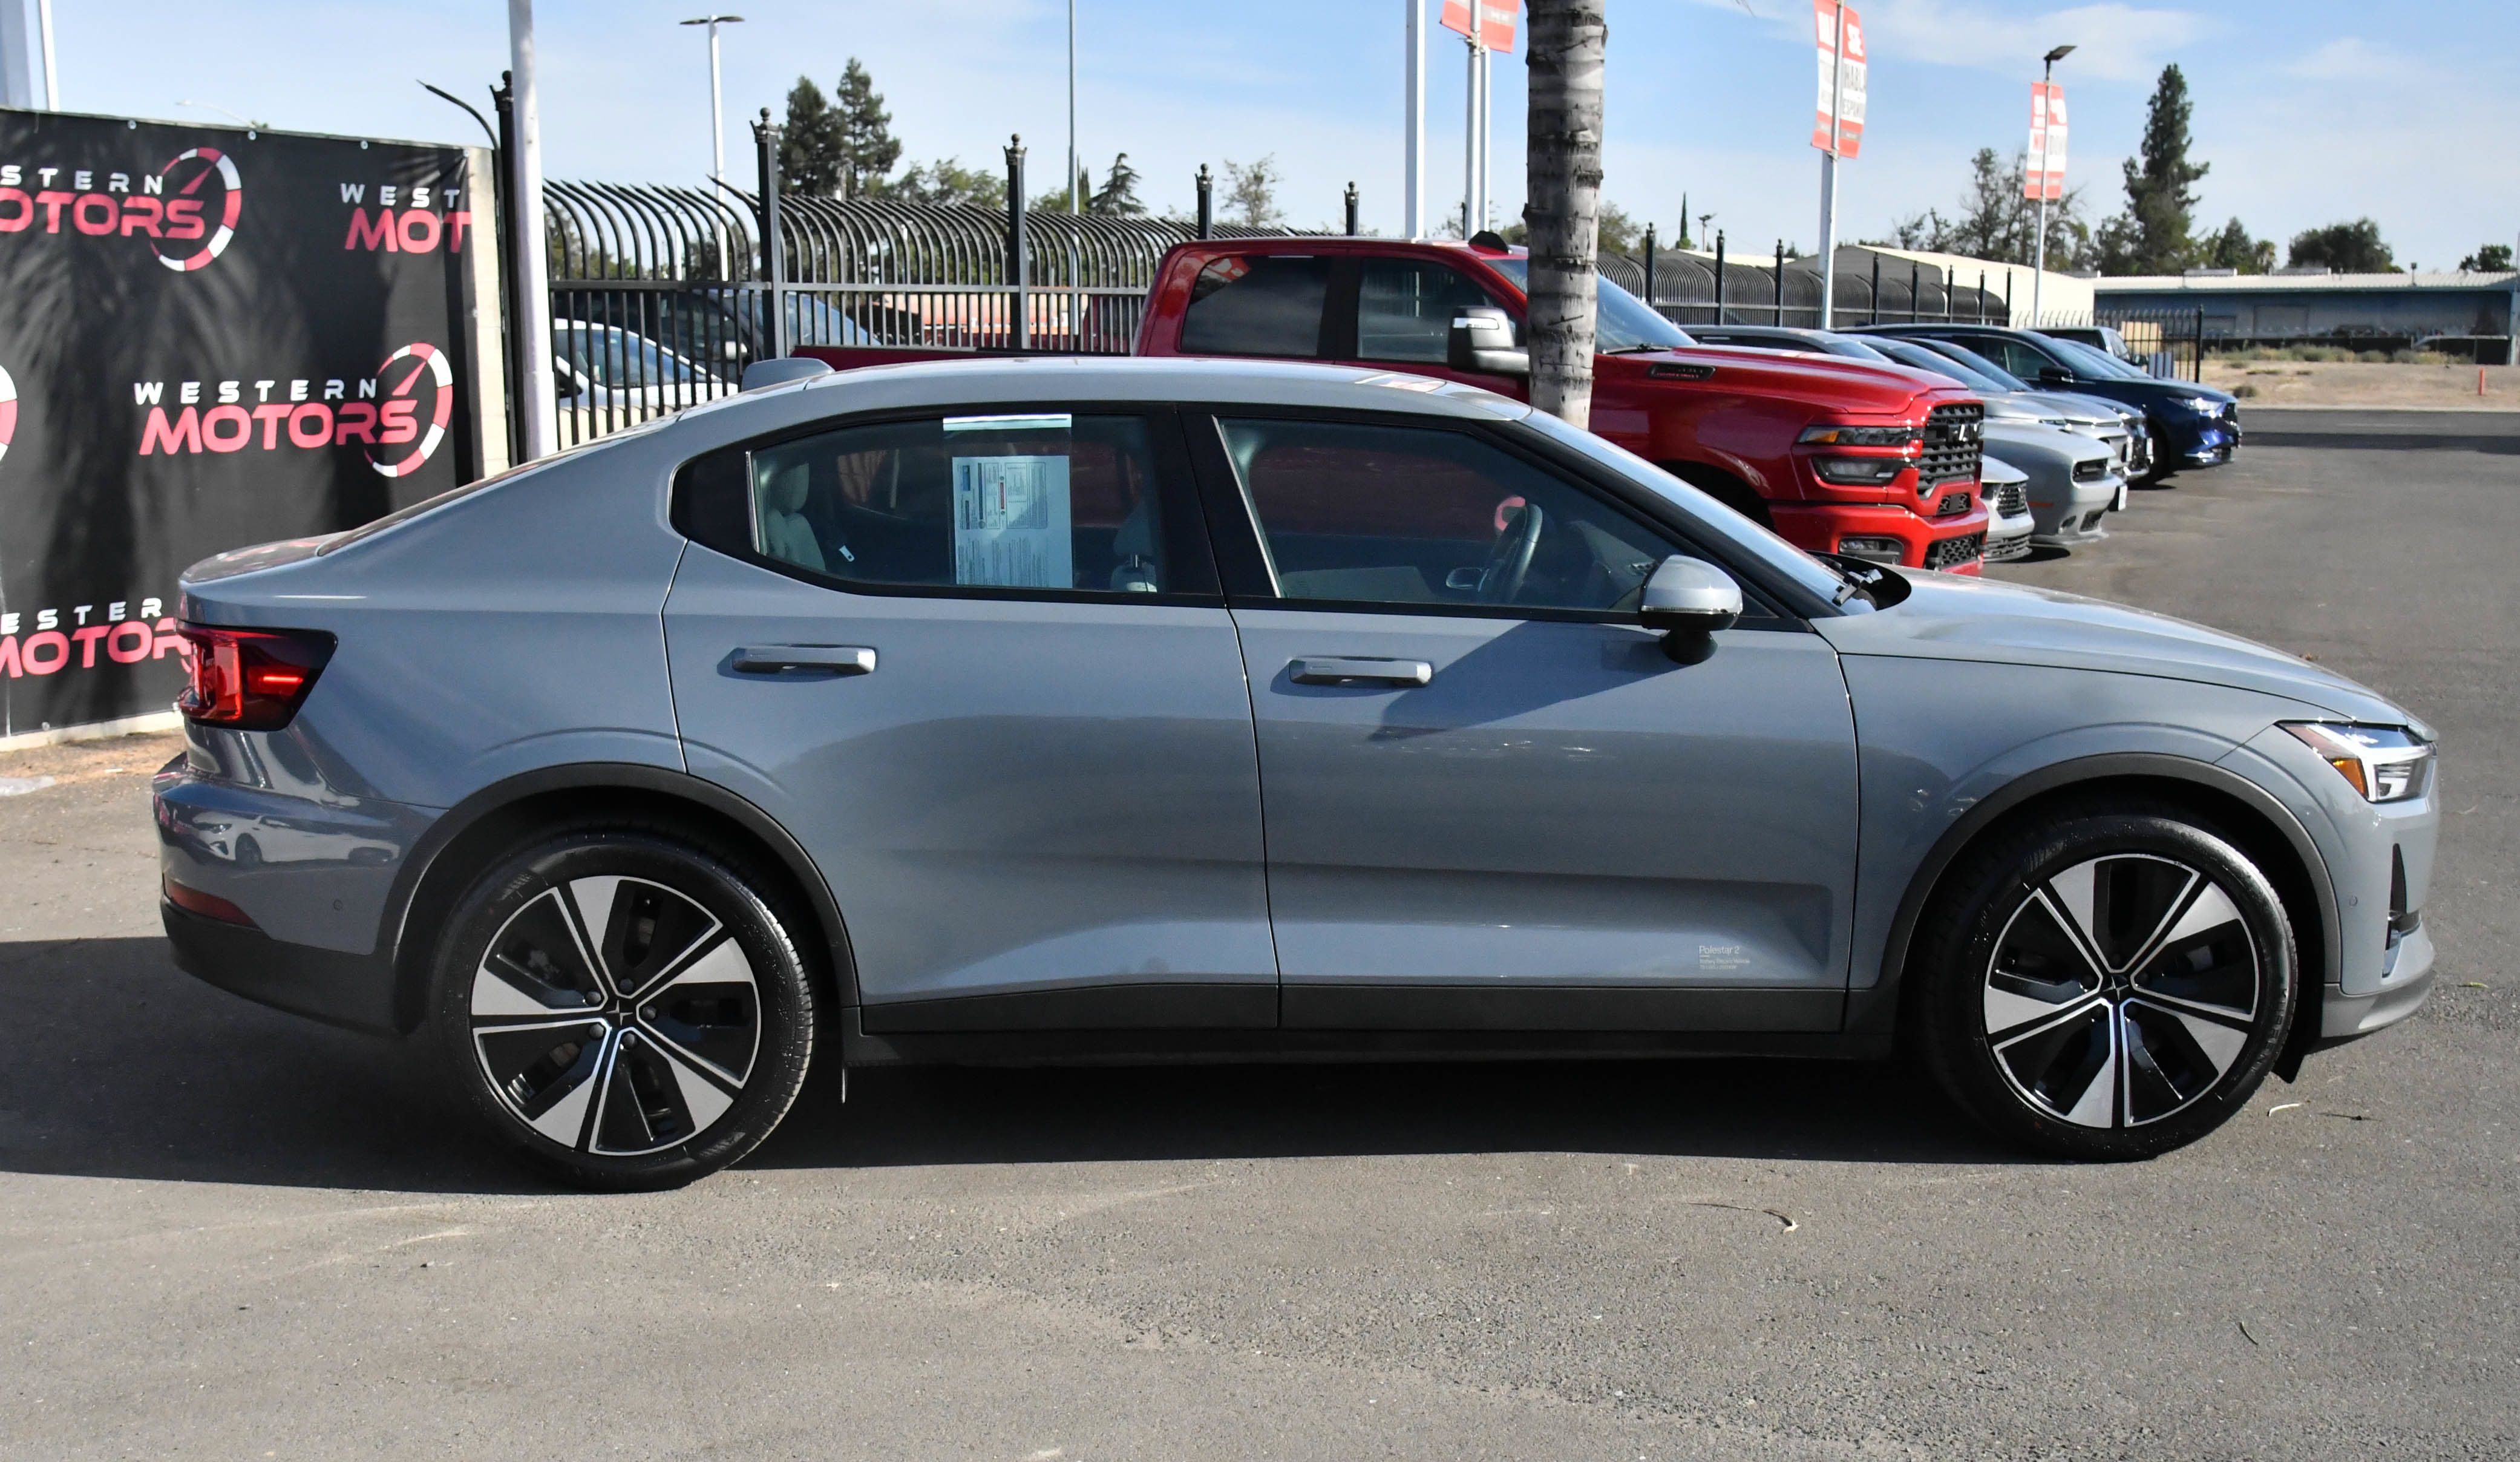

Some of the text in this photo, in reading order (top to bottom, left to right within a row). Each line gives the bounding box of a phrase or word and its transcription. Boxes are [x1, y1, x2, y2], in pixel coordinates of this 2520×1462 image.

[0, 165, 163, 195] STERN
[341, 183, 460, 208] WEST
[345, 208, 472, 254] MOT
[134, 379, 377, 405] WESTERN
[139, 399, 419, 456] MOTORS
[0, 597, 162, 635] ESTER
[1699, 945, 1740, 954] Polestar 2
